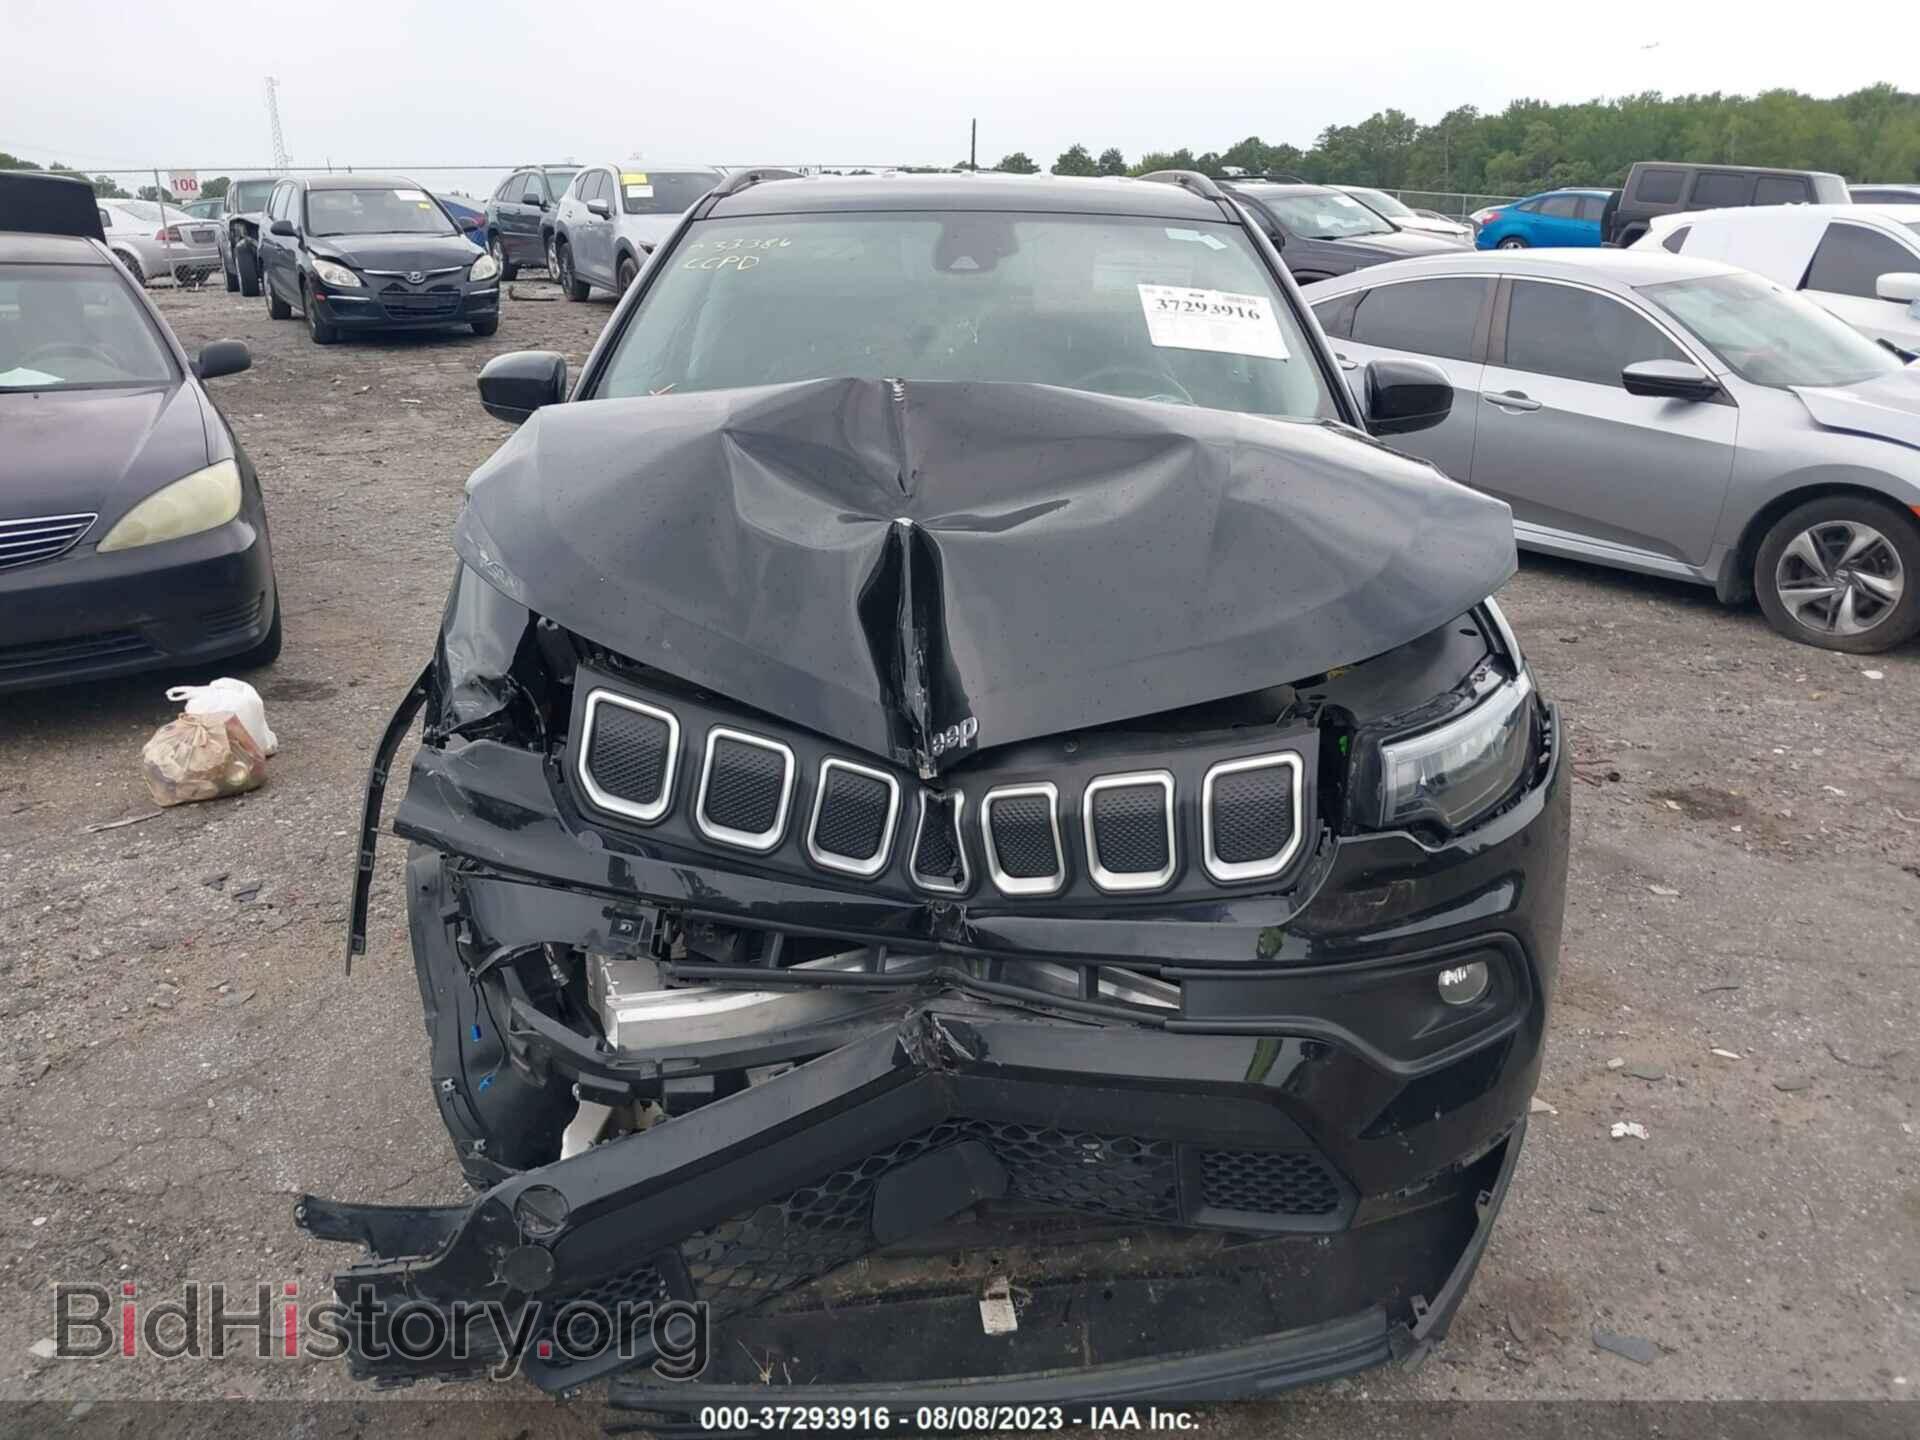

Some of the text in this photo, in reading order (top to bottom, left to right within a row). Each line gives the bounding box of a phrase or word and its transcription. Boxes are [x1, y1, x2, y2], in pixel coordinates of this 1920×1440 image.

[170, 178, 198, 191] 100
[1155, 298, 1261, 321] 37293916
[931, 716, 978, 756] eep
